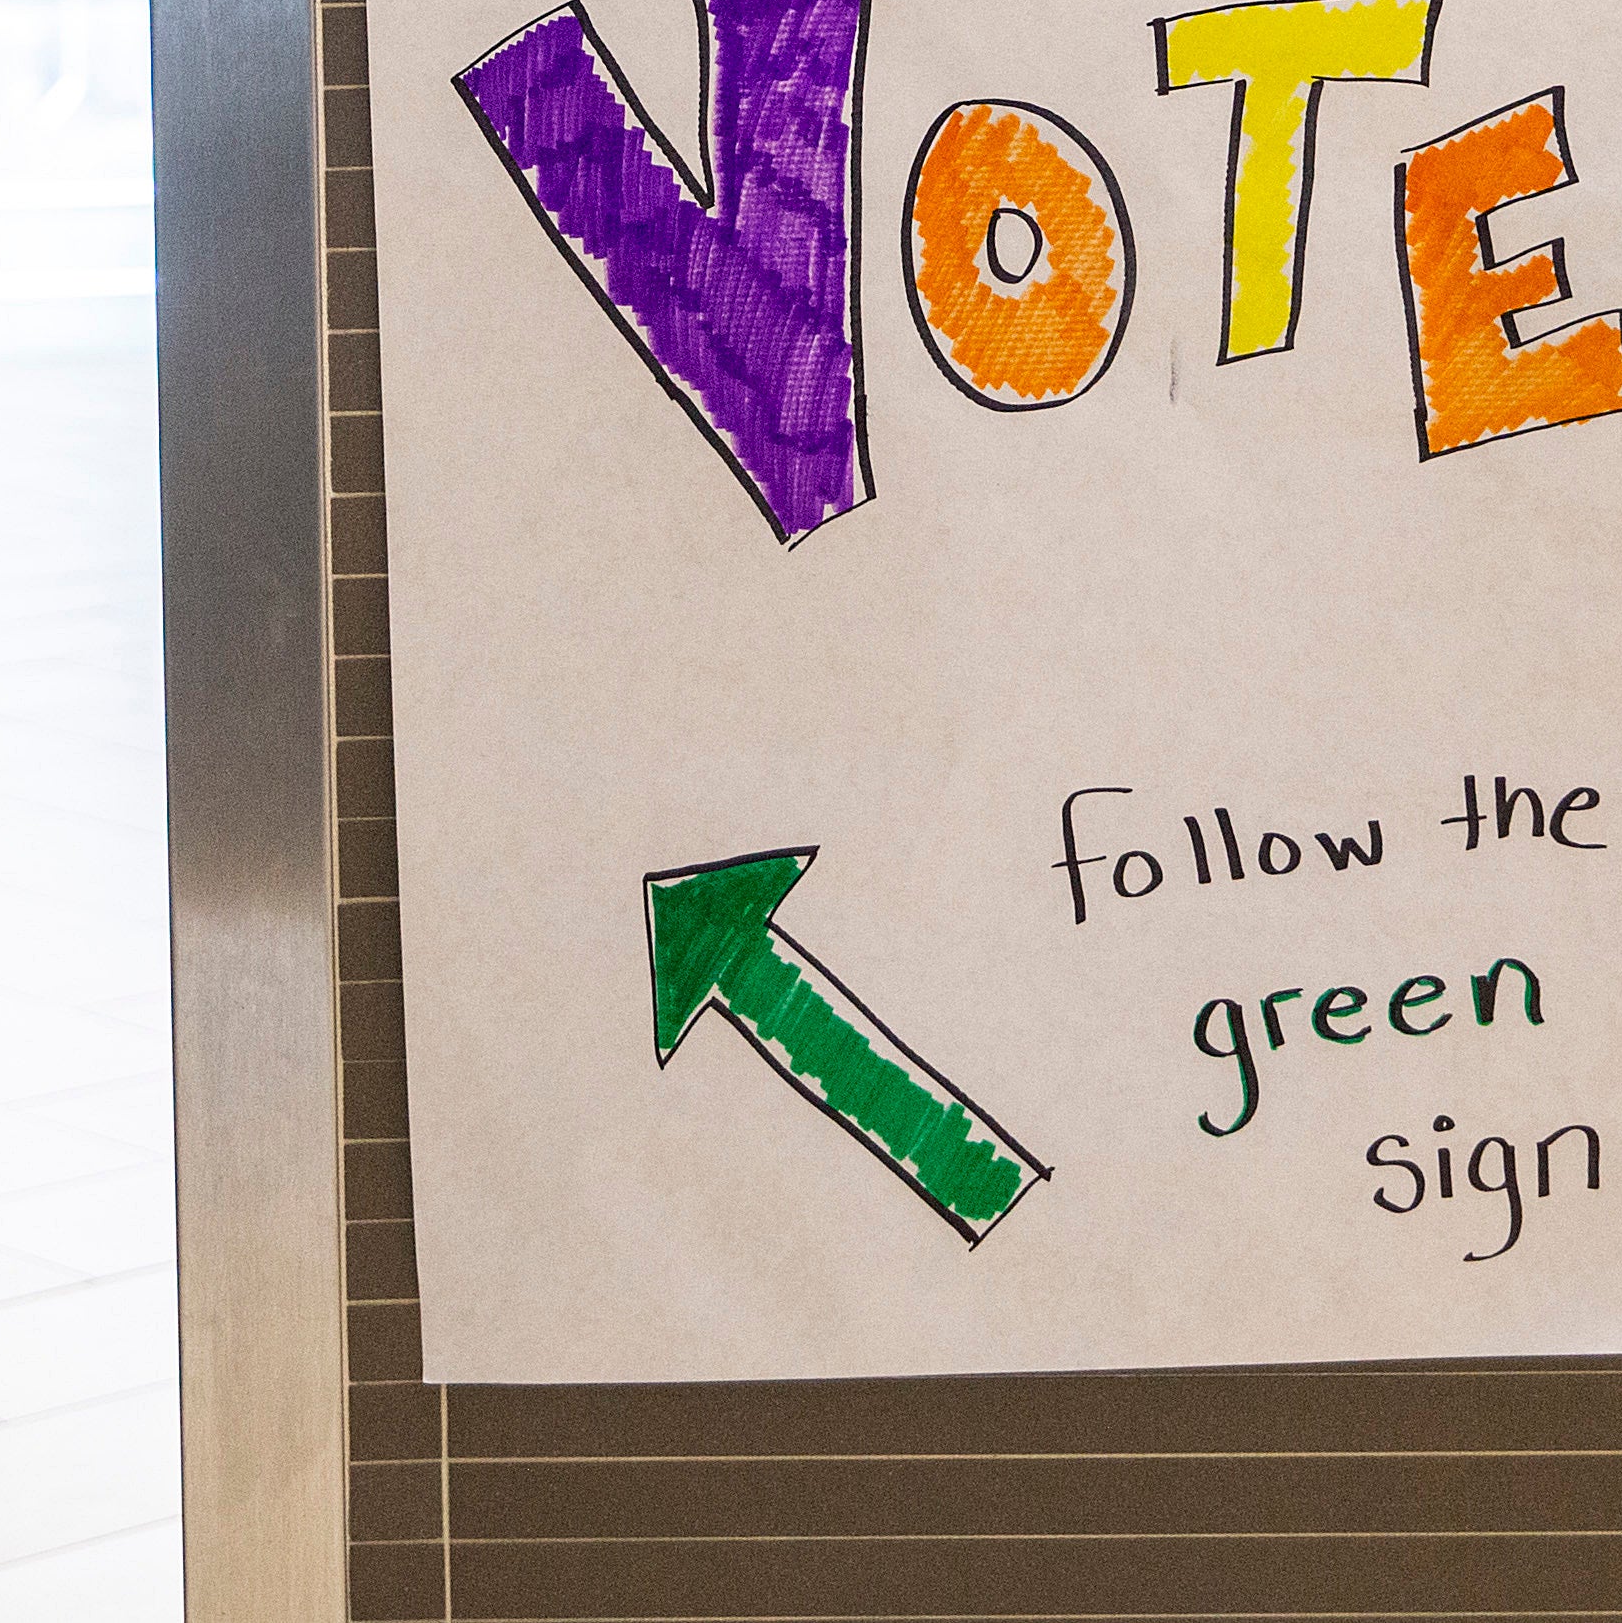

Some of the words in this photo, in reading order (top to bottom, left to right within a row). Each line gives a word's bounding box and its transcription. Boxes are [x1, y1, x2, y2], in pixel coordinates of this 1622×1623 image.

[1050, 786, 1385, 926] follow
[1441, 773, 1612, 852] the
[1192, 951, 1544, 1137] green
[1366, 1115, 1604, 1263] sign
